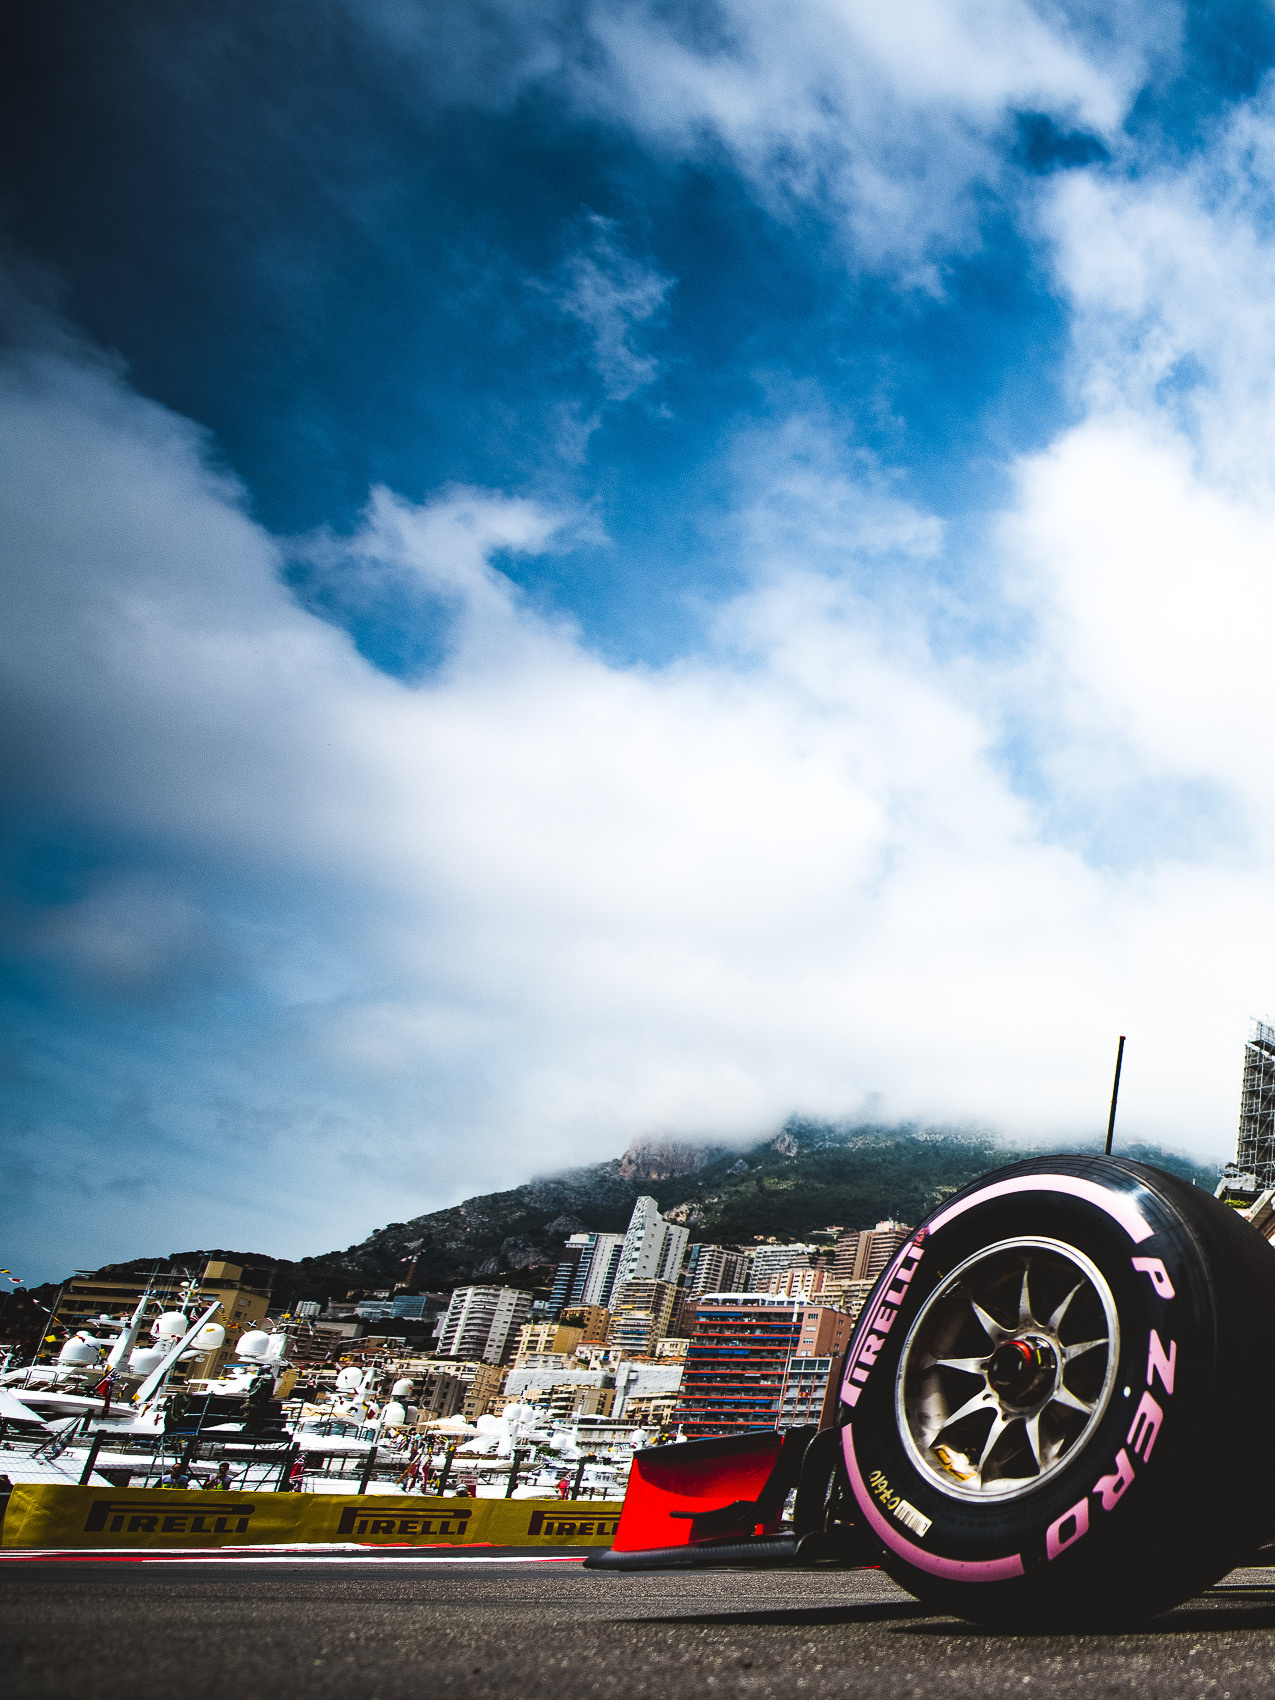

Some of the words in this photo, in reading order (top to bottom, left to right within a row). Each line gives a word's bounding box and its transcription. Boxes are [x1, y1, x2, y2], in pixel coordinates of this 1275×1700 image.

[1131, 1256, 1176, 1300] P
[840, 1241, 925, 1408] PIRELLI
[1046, 1328, 1177, 1560] ZERO
[84, 1500, 256, 1534] PIRELLI
[336, 1506, 473, 1536] PIRELLI
